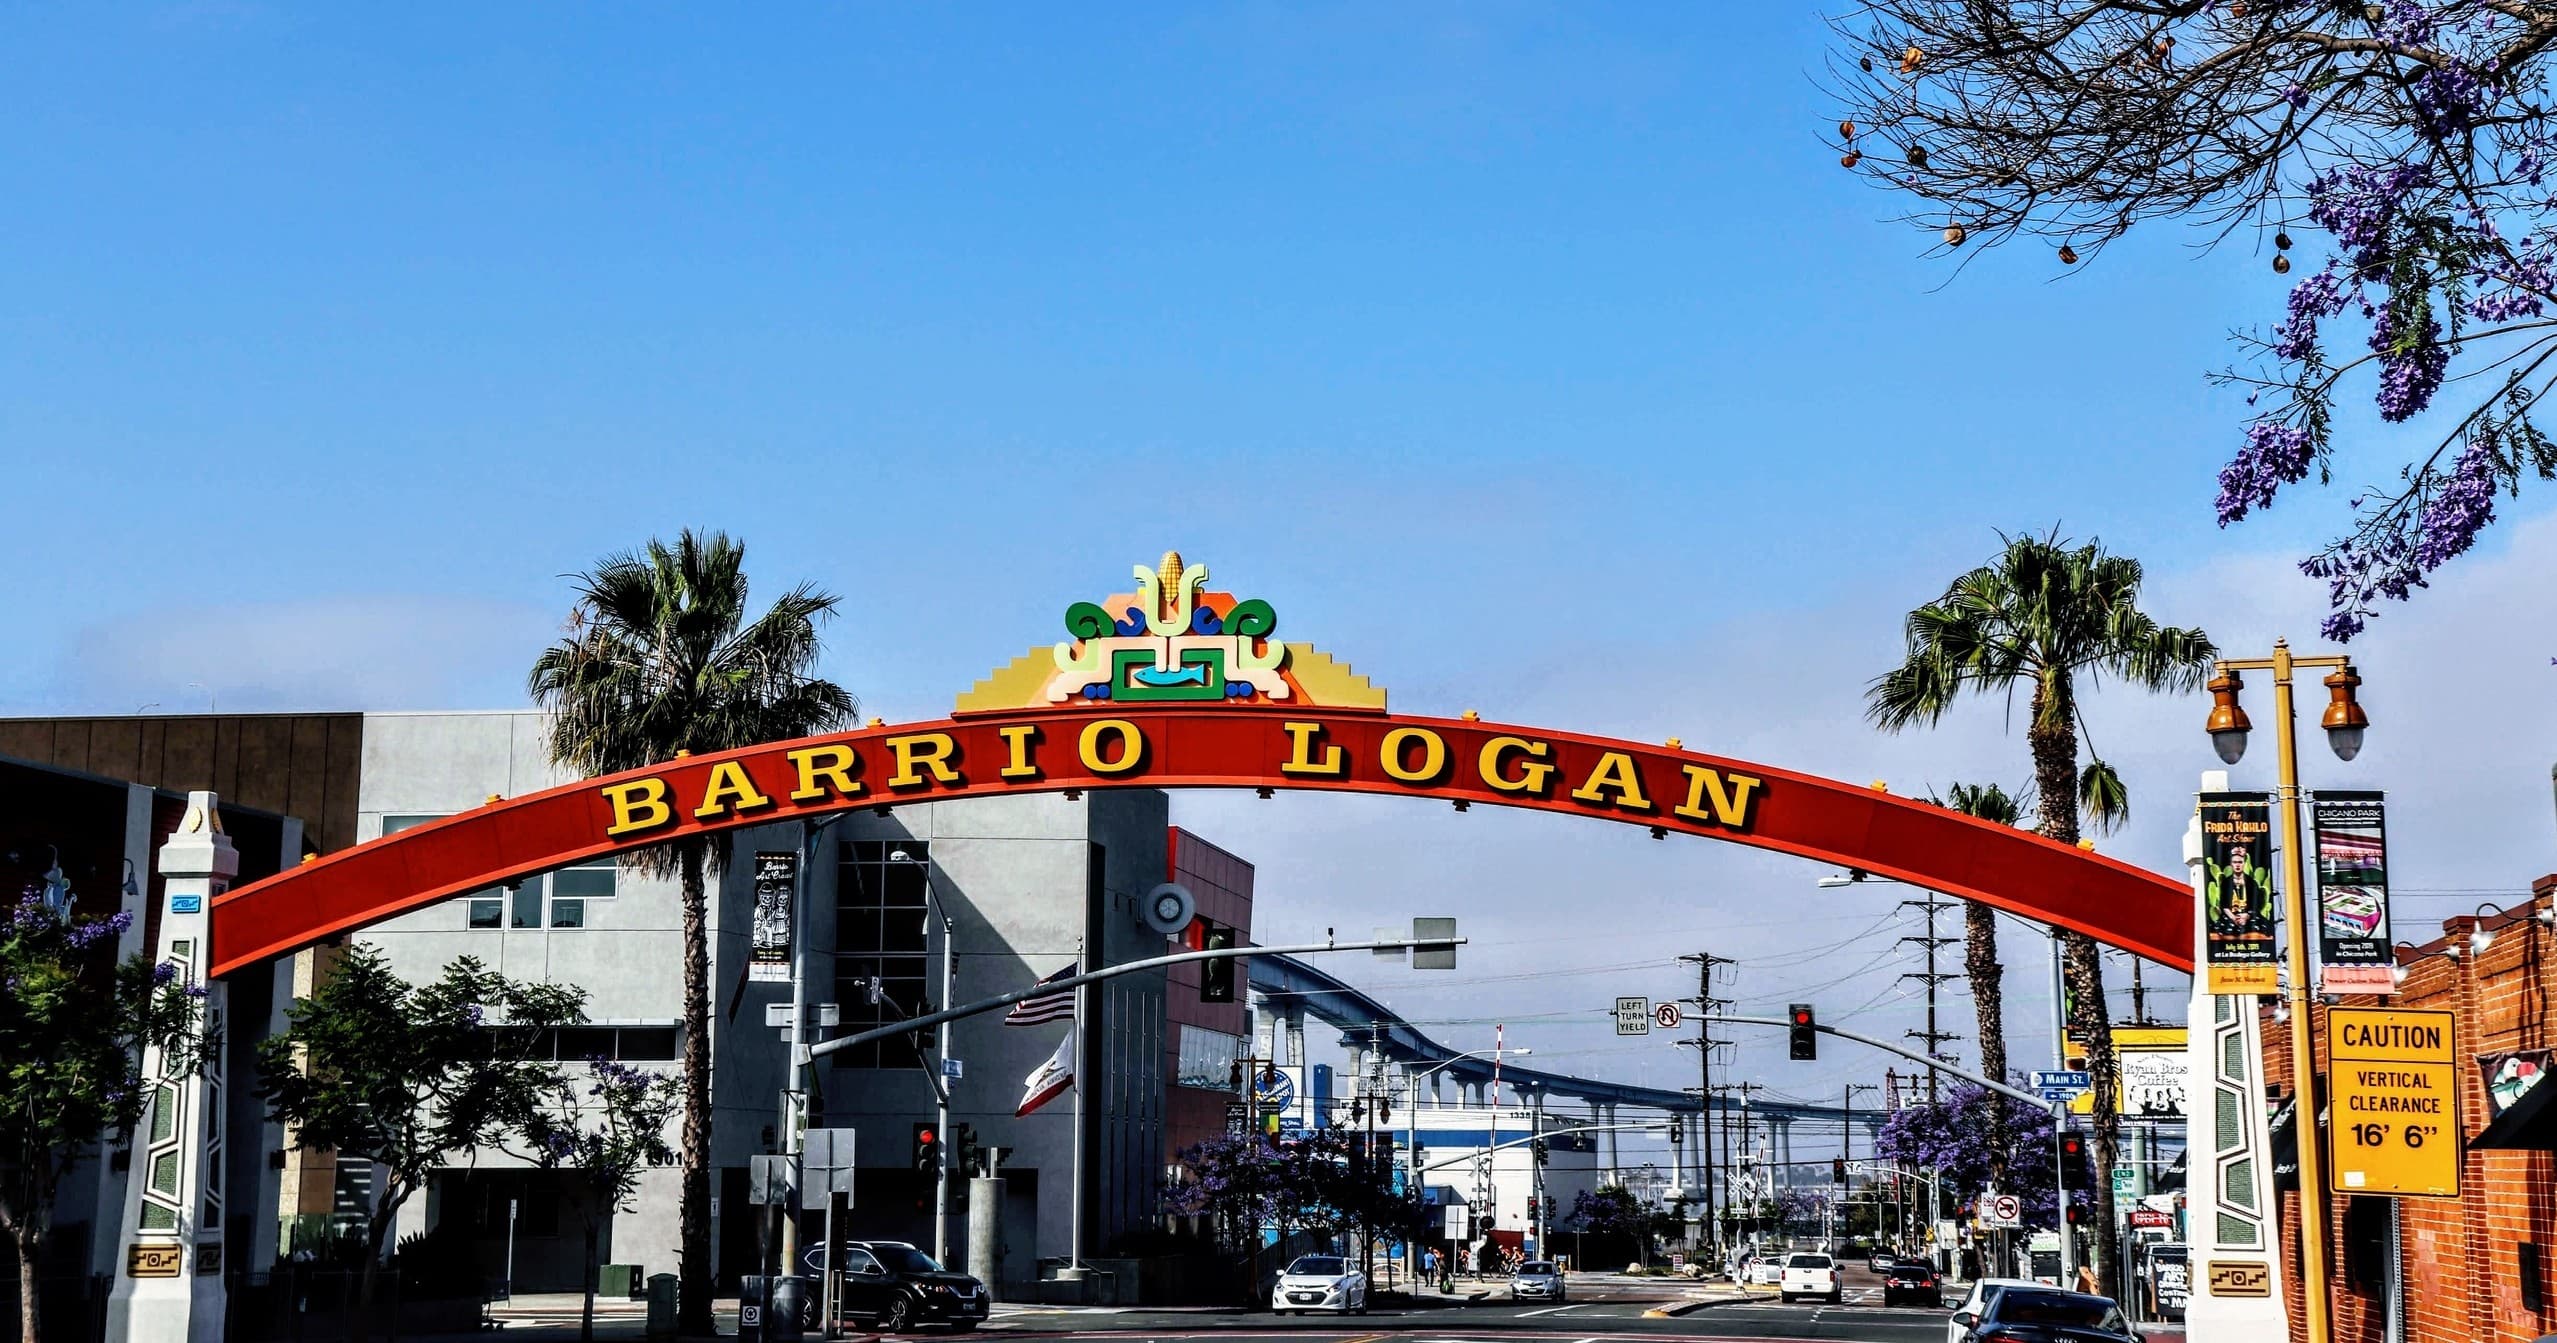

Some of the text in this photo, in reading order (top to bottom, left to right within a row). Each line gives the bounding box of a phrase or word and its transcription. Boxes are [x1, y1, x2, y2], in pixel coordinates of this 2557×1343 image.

[602, 719, 1761, 836] BARRIO LOGAN
[2228, 811, 2241, 820] The
[2318, 809, 2381, 817] CHICANO PARK
[2205, 821, 2268, 833] FRIDA KAHLO
[2217, 833, 2256, 843] Art Show
[2339, 943, 2361, 951] Opening
[1621, 1001, 1642, 1010] LEFT
[1621, 1012, 1644, 1021] TURN
[1620, 1023, 1646, 1031] YIELD
[2343, 1024, 2440, 1049] CAUTION
[2124, 1063, 2188, 1077] Ryan Bros
[2138, 1075, 2179, 1086] Coffee
[2357, 1071, 2432, 1089] VERTICAL
[2349, 1095, 2441, 1114] CLEARANCE
